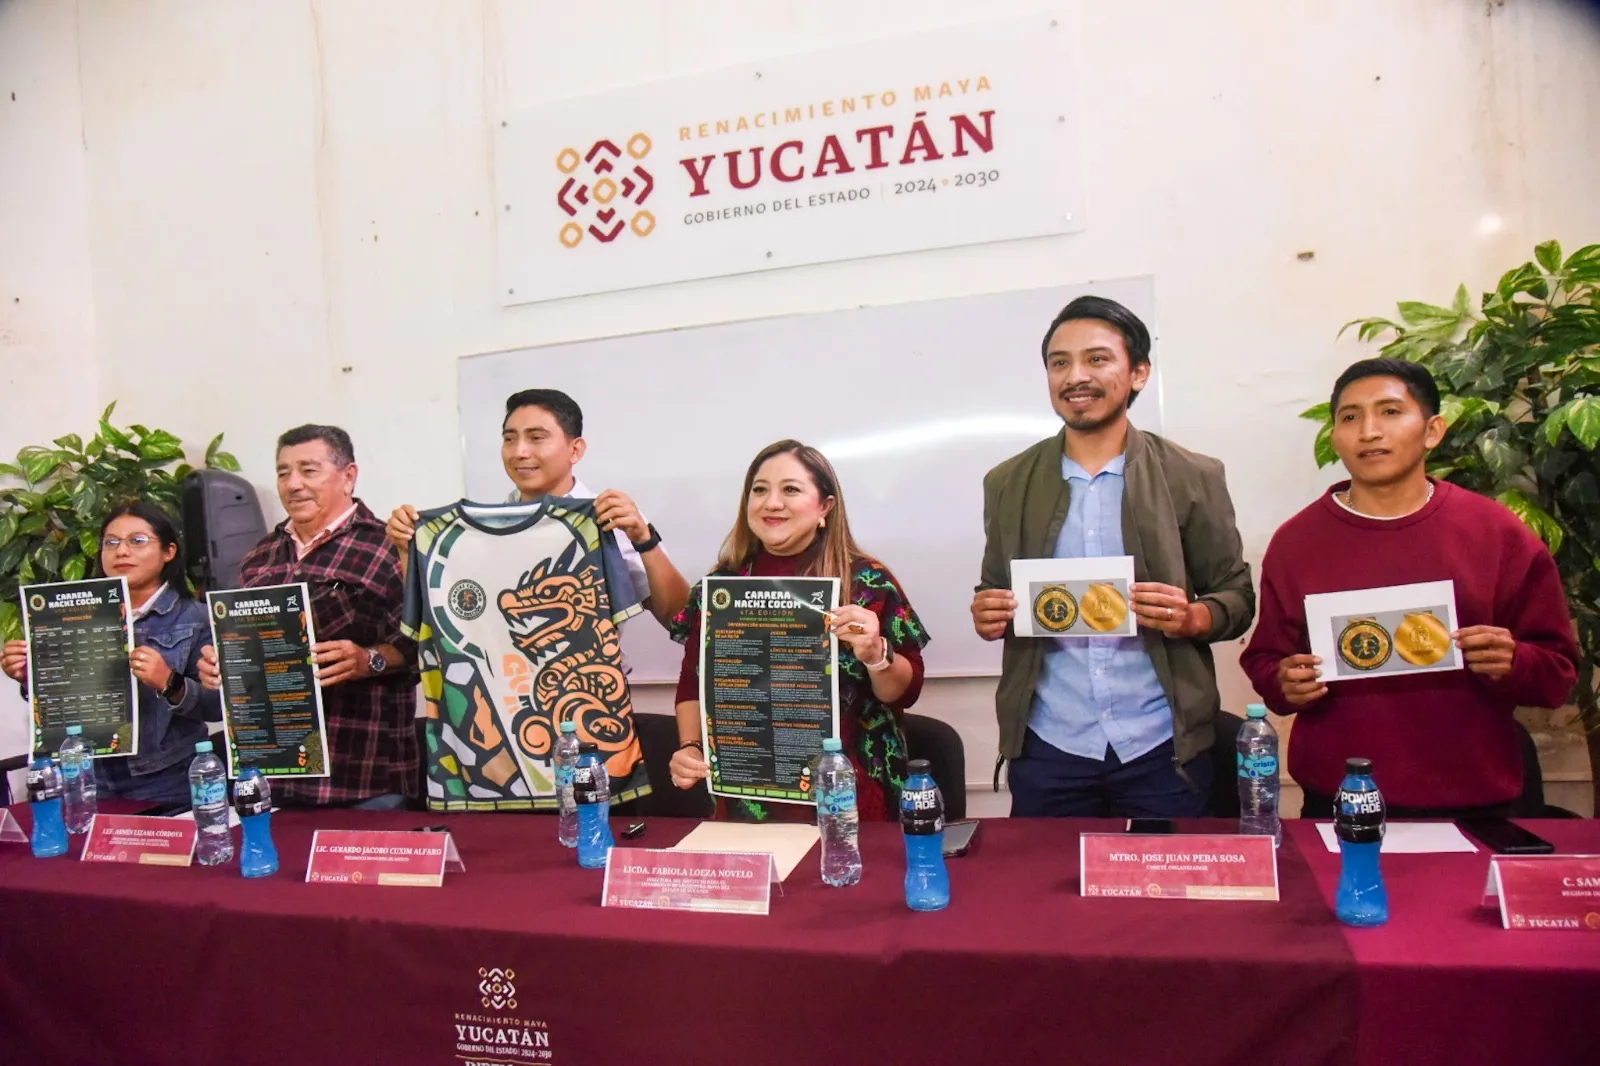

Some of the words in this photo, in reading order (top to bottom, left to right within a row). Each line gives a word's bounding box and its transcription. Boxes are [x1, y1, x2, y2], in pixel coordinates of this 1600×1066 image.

[678, 90, 896, 142] RENACIMIENTO
[913, 75, 992, 102] MAYA
[678, 110, 998, 198] YUCATÁN
[683, 202, 767, 226] GOBIERNO
[772, 196, 803, 212] DEL
[808, 186, 871, 207] ESTADO
[894, 178, 938, 196] 2024
[954, 169, 1000, 190] 2030
[56, 590, 93, 600] CARRERA
[745, 591, 791, 600] CARRERA
[48, 600, 74, 608] NACHI
[76, 597, 102, 606] COCOM
[235, 599, 271, 608] CARRERA
[734, 600, 767, 608] NACHI
[768, 600, 802, 609] COCOM
[229, 608, 252, 617] NACHI
[253, 606, 280, 615] COCOM
[901, 790, 936, 801] POWER
[1341, 791, 1380, 804] POWER
[915, 800, 936, 810] ADE
[1361, 802, 1381, 814] ADE
[362, 846, 389, 855] JACOBO
[414, 848, 442, 856] ALFARO
[1110, 854, 1140, 862] MTRO.
[1141, 854, 1164, 863] JOSE
[1165, 854, 1190, 863] JUAN
[1193, 854, 1218, 863] PEBA
[1220, 854, 1246, 863] SOSA
[624, 865, 650, 874] LICDA.
[652, 867, 688, 876] FABIOLA
[718, 870, 753, 878] NOVELO
[320, 874, 348, 882] YUCATÁN
[1563, 877, 1575, 886] C.
[1577, 878, 1600, 886] SAM
[1102, 887, 1141, 896] YUCATÁN
[1528, 917, 1579, 927] YUCATÁN
[455, 1013, 520, 1026] RENACIMIENTO
[524, 1020, 547, 1028] MAYA
[455, 1025, 549, 1047] YUCATÁN
[457, 1043, 484, 1052] GOBIERNO
[485, 1045, 494, 1053] DEL
[496, 1046, 518, 1055] ESTADO
